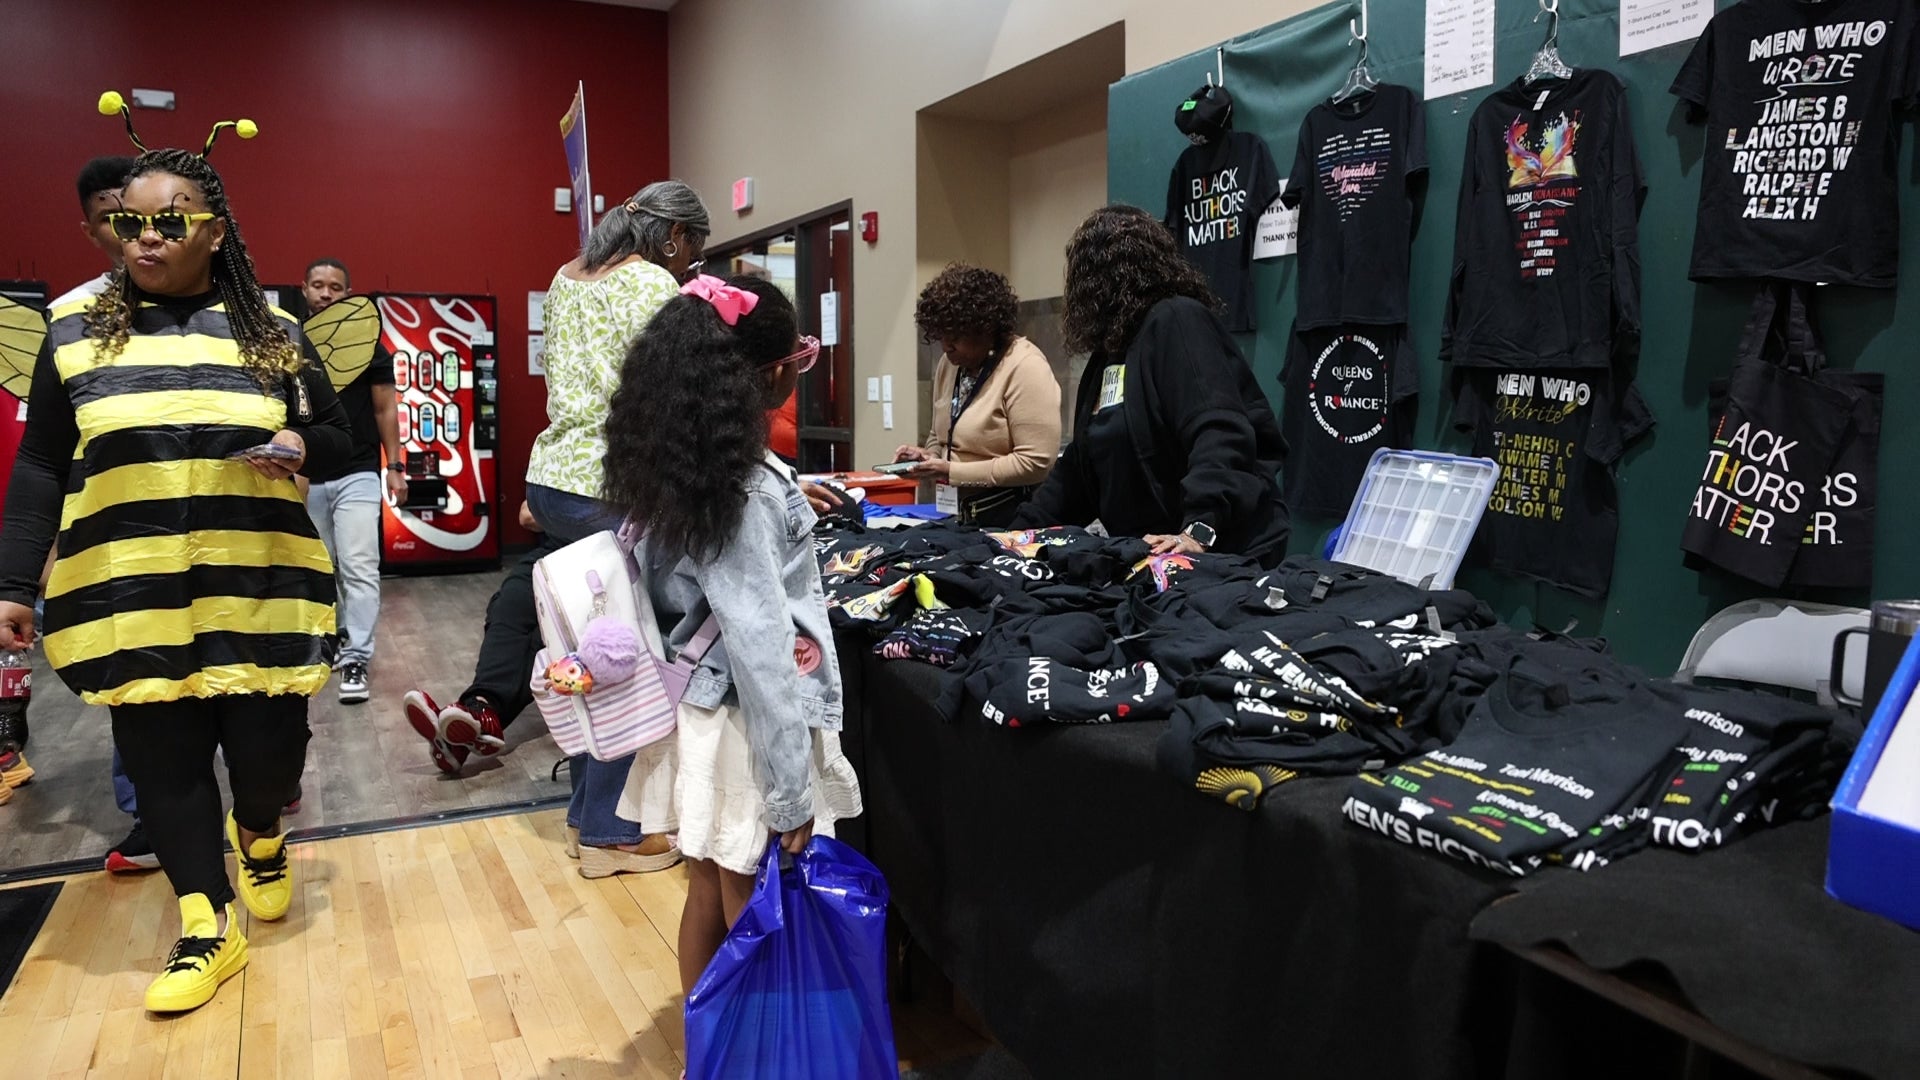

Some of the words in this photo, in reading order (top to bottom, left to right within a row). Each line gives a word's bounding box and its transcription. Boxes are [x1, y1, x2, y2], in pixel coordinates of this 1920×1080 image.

[1748, 28, 1807, 62] MEN
[1814, 20, 1887, 49] WHO
[1763, 53, 1863, 85] WROTE
[1758, 95, 1828, 126] JAMES
[1832, 95, 1848, 120] B
[1725, 121, 1841, 150] LANGSTON
[1844, 120, 1862, 146] H
[1732, 147, 1827, 173] RICHARD
[1832, 147, 1853, 171] W
[1192, 166, 1238, 200] BLACK
[1743, 173, 1815, 196] RALPH
[1817, 172, 1832, 195] E
[1184, 189, 1247, 224] AUTHORS
[1506, 191, 1533, 206] HARLEM
[1742, 197, 1799, 219] ALEX
[1801, 197, 1820, 220] H
[1262, 232, 1285, 244] THANK
[1536, 268, 1554, 277] WEST
[1353, 335, 1379, 355] BRENDA
[1331, 364, 1373, 381] QUEENS
[1344, 380, 1354, 396] of
[1496, 373, 1536, 397] MEN
[1541, 376, 1591, 406] WHO
[1348, 423, 1383, 444] BEVERLY
[1493, 431, 1560, 455] TA-NEHISI
[1565, 442, 1575, 458] C
[1498, 449, 1550, 470] KWAME
[1555, 456, 1564, 472] A
[1493, 481, 1541, 501] JAMES
[1549, 488, 1560, 505] M
[1555, 473, 1567, 490] M
[1488, 495, 1545, 518] COLSON
[1551, 506, 1564, 521] W
[1531, 767, 1595, 800] Morrison
